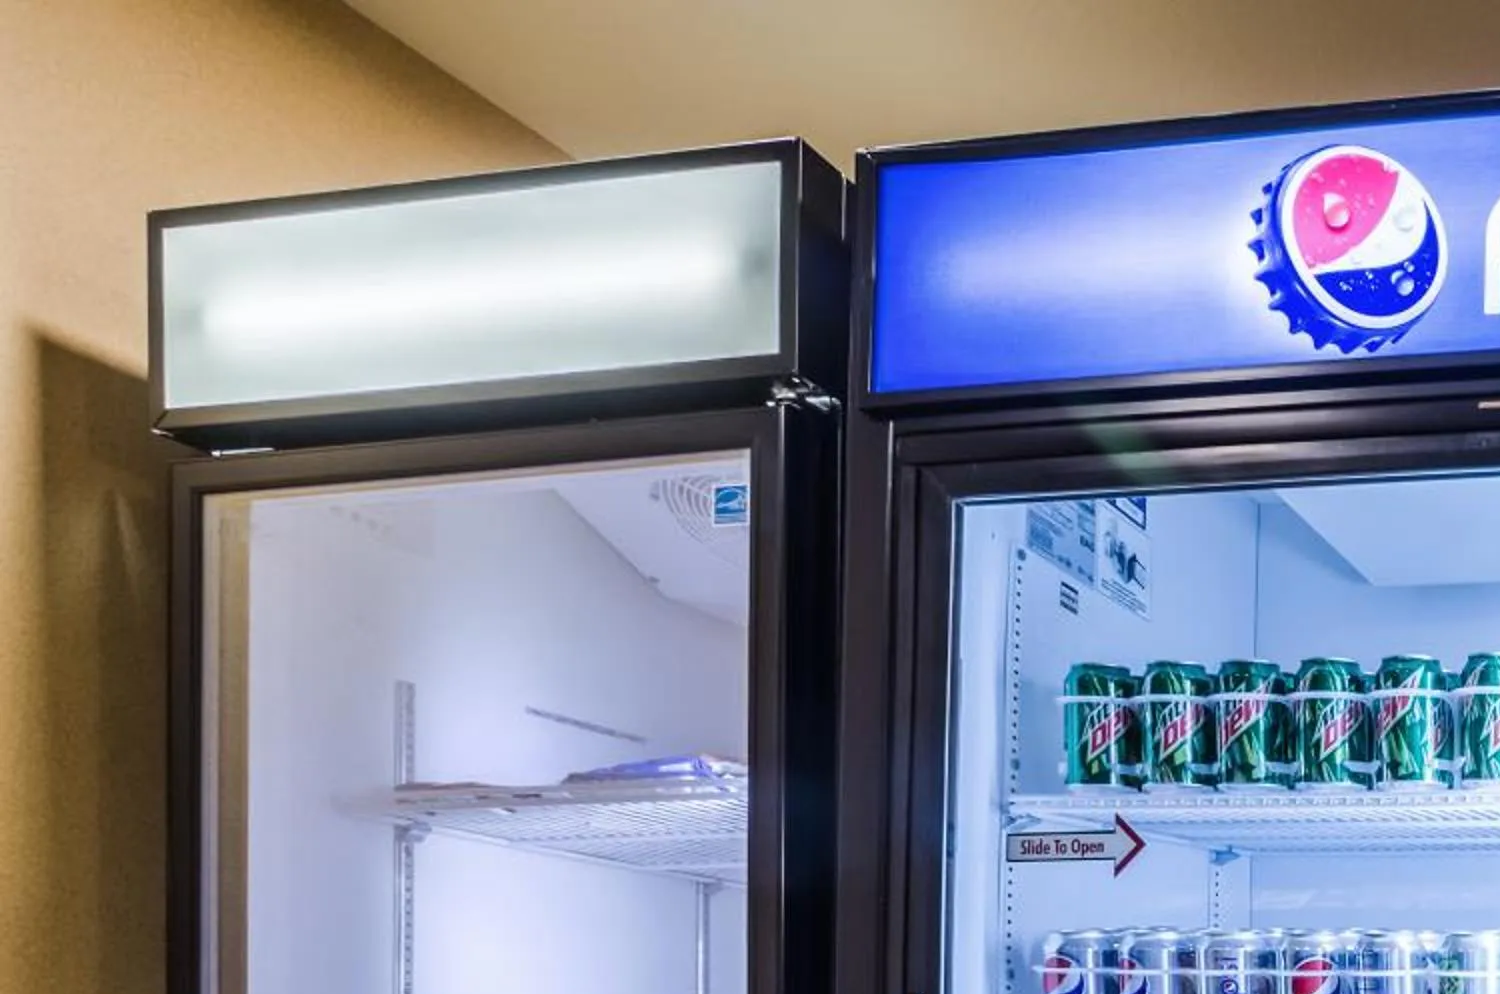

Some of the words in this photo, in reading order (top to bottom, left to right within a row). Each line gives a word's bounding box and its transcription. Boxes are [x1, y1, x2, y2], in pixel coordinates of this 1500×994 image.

[1020, 839, 1051, 855] Slide
[1054, 839, 1068, 854] To
[1071, 838, 1105, 856] Open
